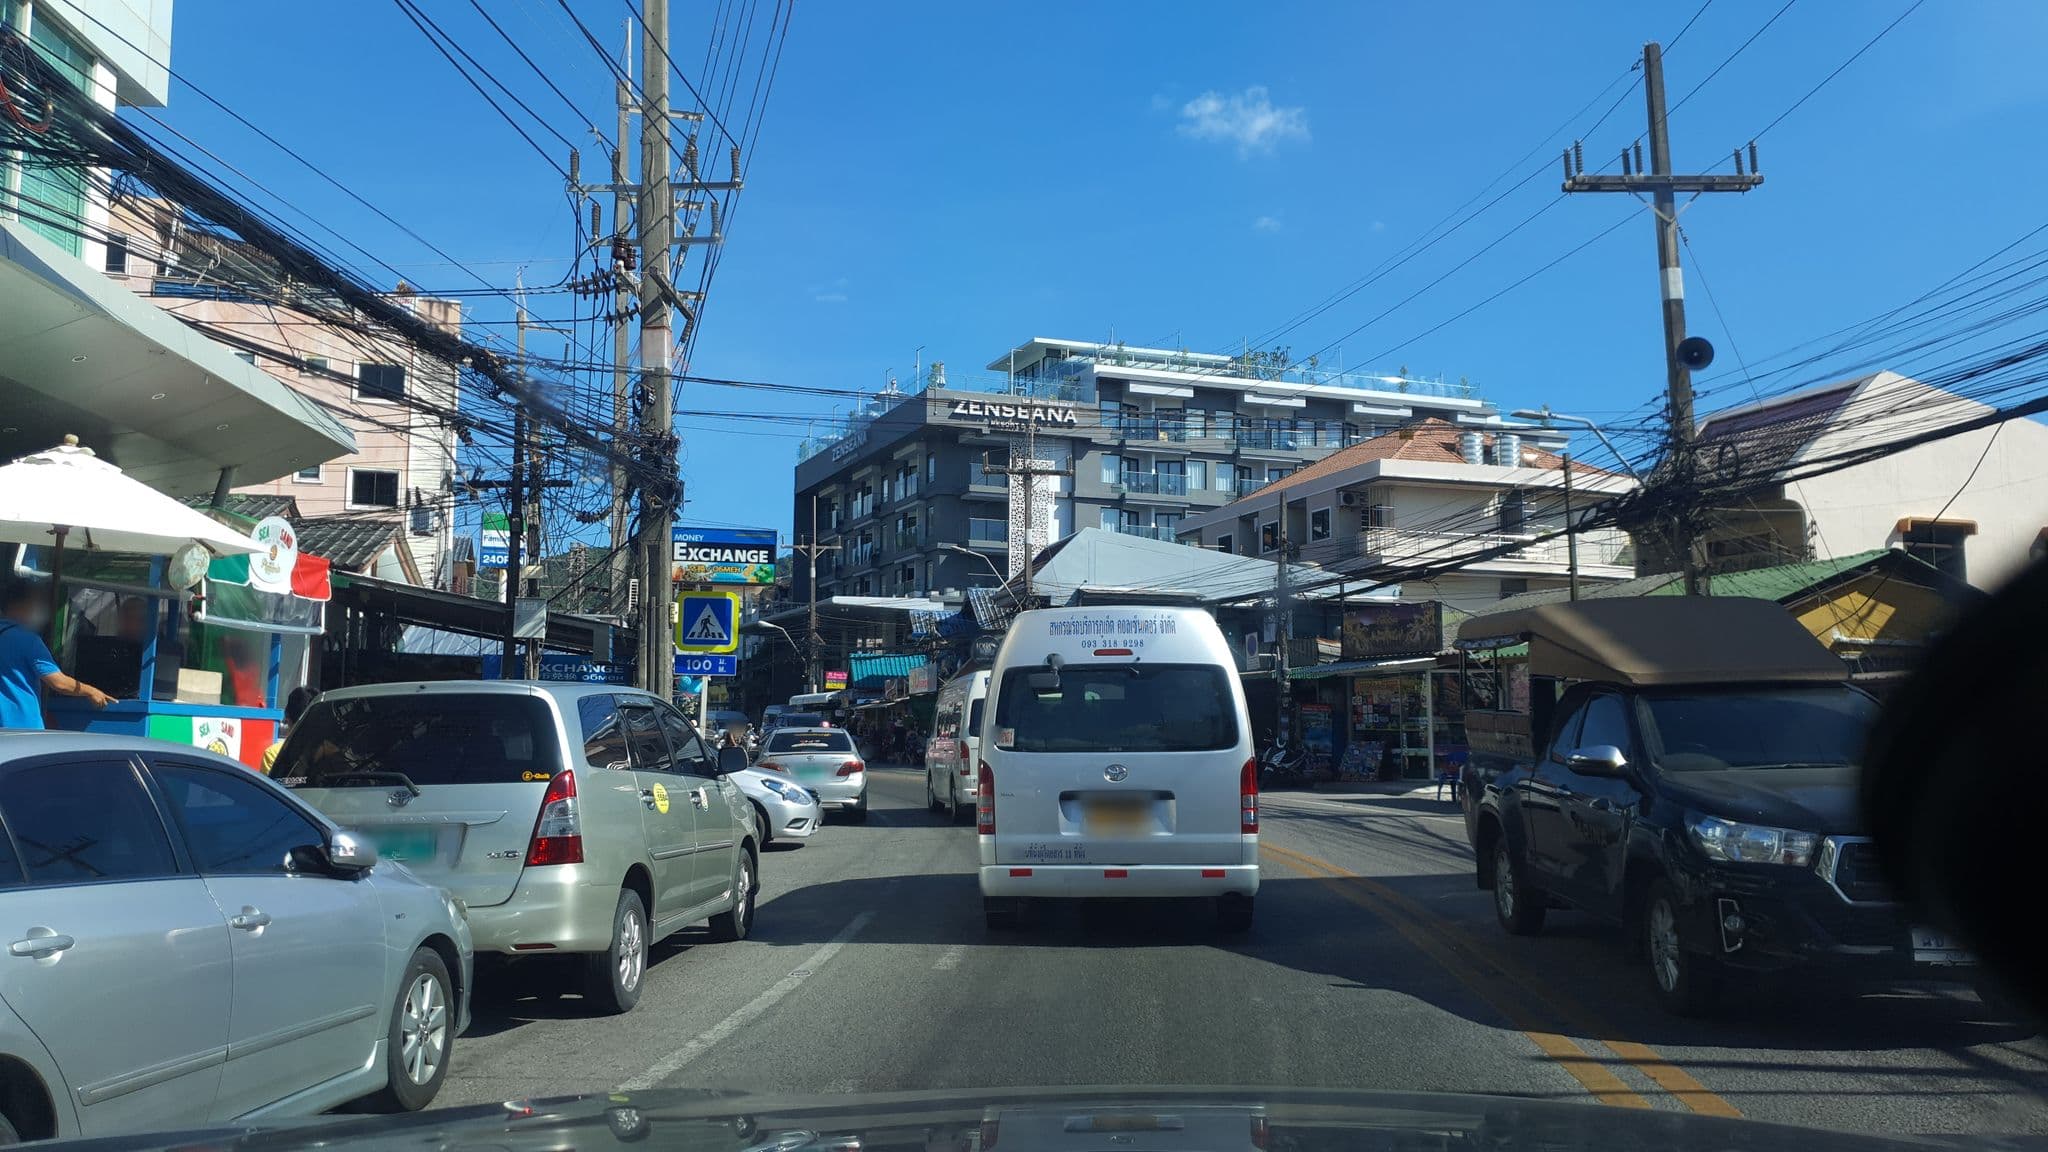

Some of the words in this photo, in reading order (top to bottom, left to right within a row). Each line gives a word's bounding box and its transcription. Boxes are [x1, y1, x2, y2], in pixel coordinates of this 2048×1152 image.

[953, 399, 1077, 424] ZENSEANA
[674, 533, 704, 541] MONEY
[673, 542, 769, 563] EXCHANGE
[1081, 639, 1097, 648] 093
[1102, 639, 1118, 648] 318
[1122, 639, 1144, 648] 9298
[539, 664, 625, 673] XCHANGE
[686, 659, 712, 671] 100
[199, 722, 211, 738] SEA
[221, 721, 235, 738] SAND
